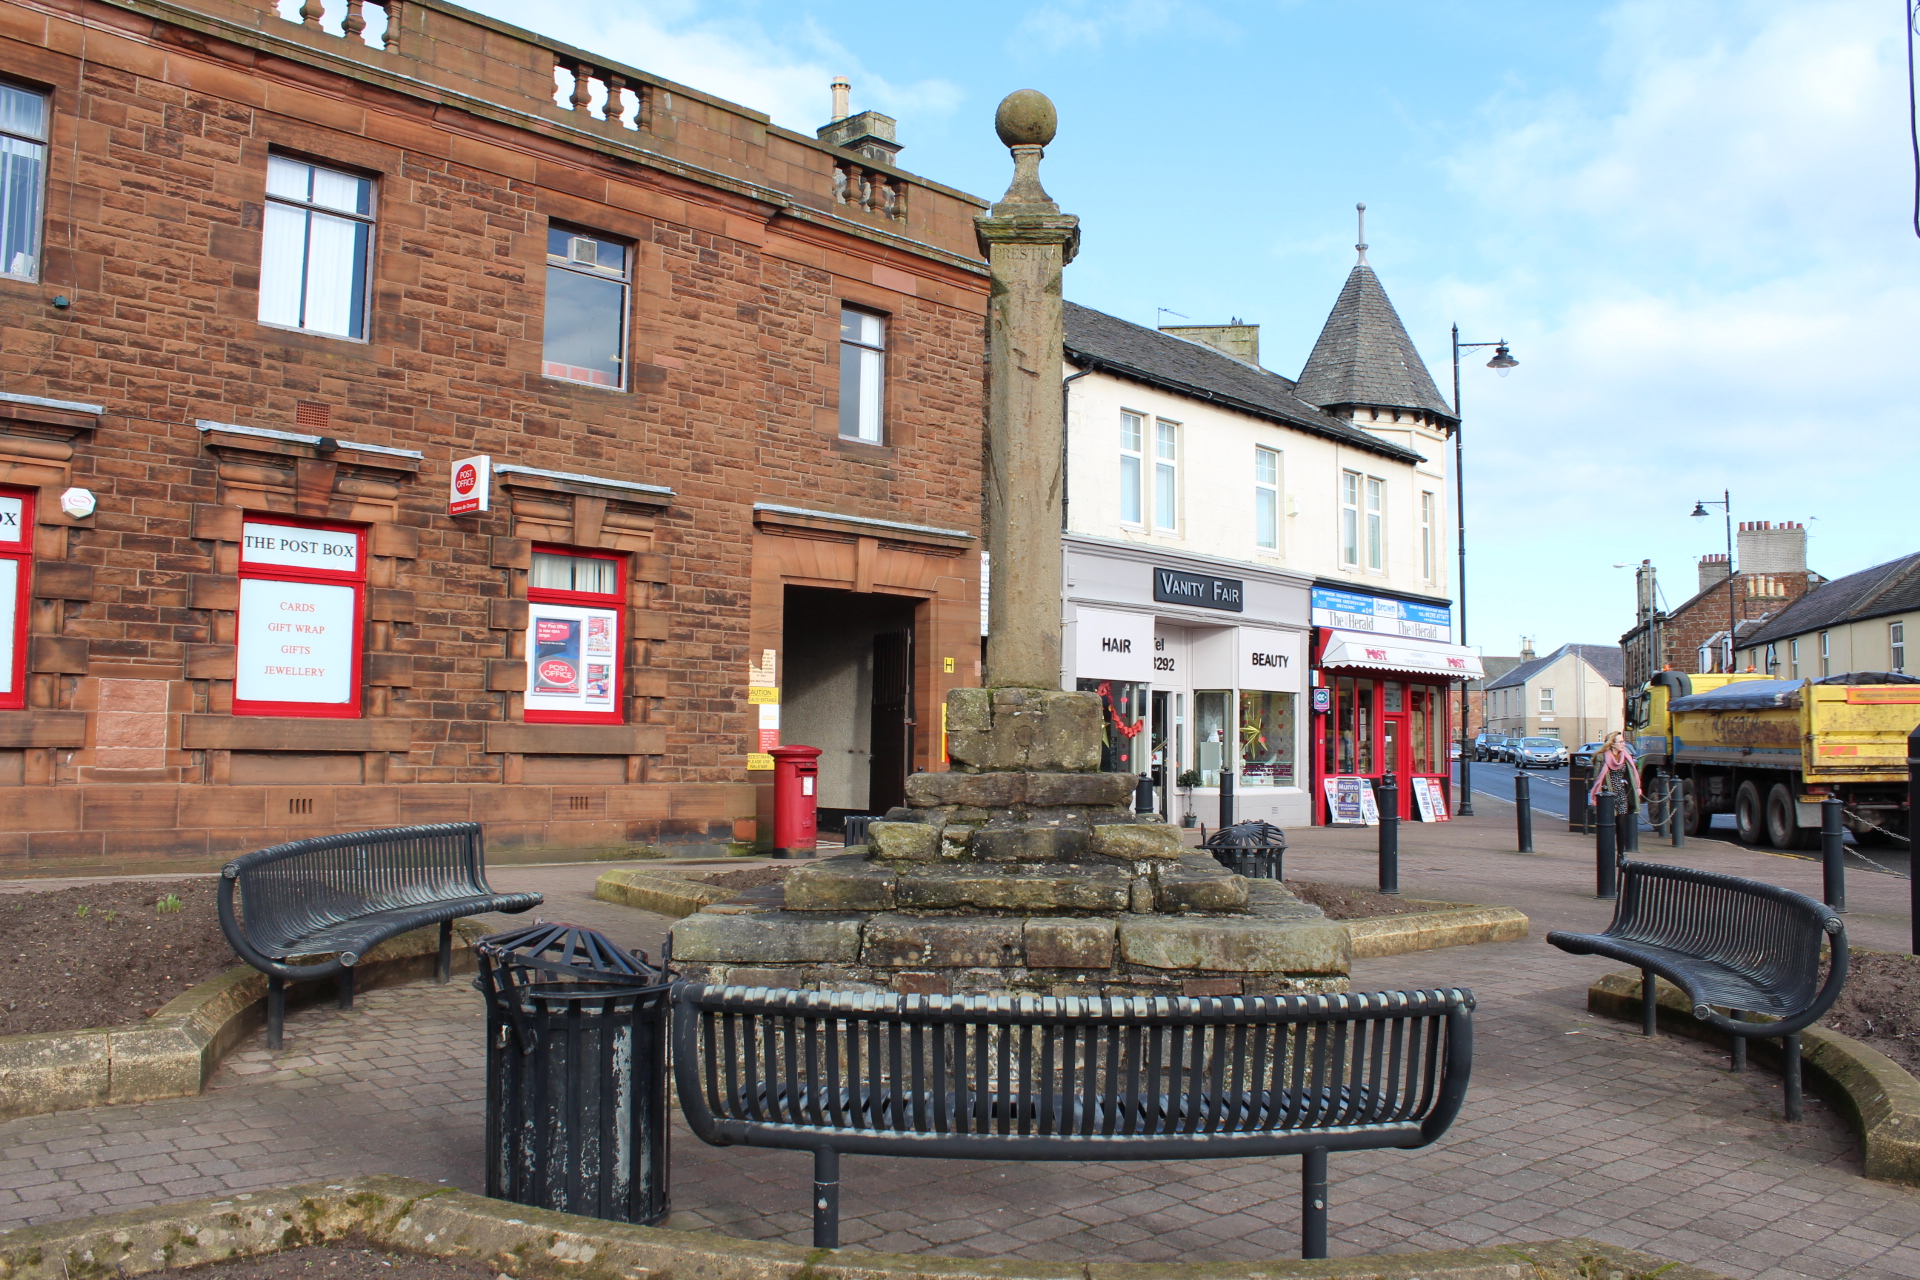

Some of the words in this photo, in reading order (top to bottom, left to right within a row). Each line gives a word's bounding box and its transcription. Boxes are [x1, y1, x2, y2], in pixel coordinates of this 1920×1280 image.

[460, 470, 473, 479] POST
[457, 478, 474, 488] OFFICE
[0, 511, 17, 526] X
[244, 536, 276, 550] THE
[280, 539, 319, 554] POST
[322, 543, 355, 558] BOX
[1161, 572, 1205, 598] VANITY
[1213, 580, 1240, 603] FAIR
[280, 602, 315, 612] CARDS
[1328, 611, 1344, 627] The
[1348, 614, 1374, 631] Herald
[268, 623, 292, 632] GIFT
[295, 624, 325, 634] WRAP
[1397, 621, 1411, 636] The
[1415, 623, 1437, 639] Herald
[281, 645, 311, 654] GIFTS
[1102, 637, 1131, 653] HAIR
[1252, 652, 1289, 668] BEAUTY
[1365, 648, 1388, 661] POST
[549, 664, 569, 672] POST
[1446, 657, 1466, 669] POST
[264, 665, 326, 676] JEWELLERY
[544, 670, 572, 679] OFFICE
[1339, 783, 1359, 791] Munro
